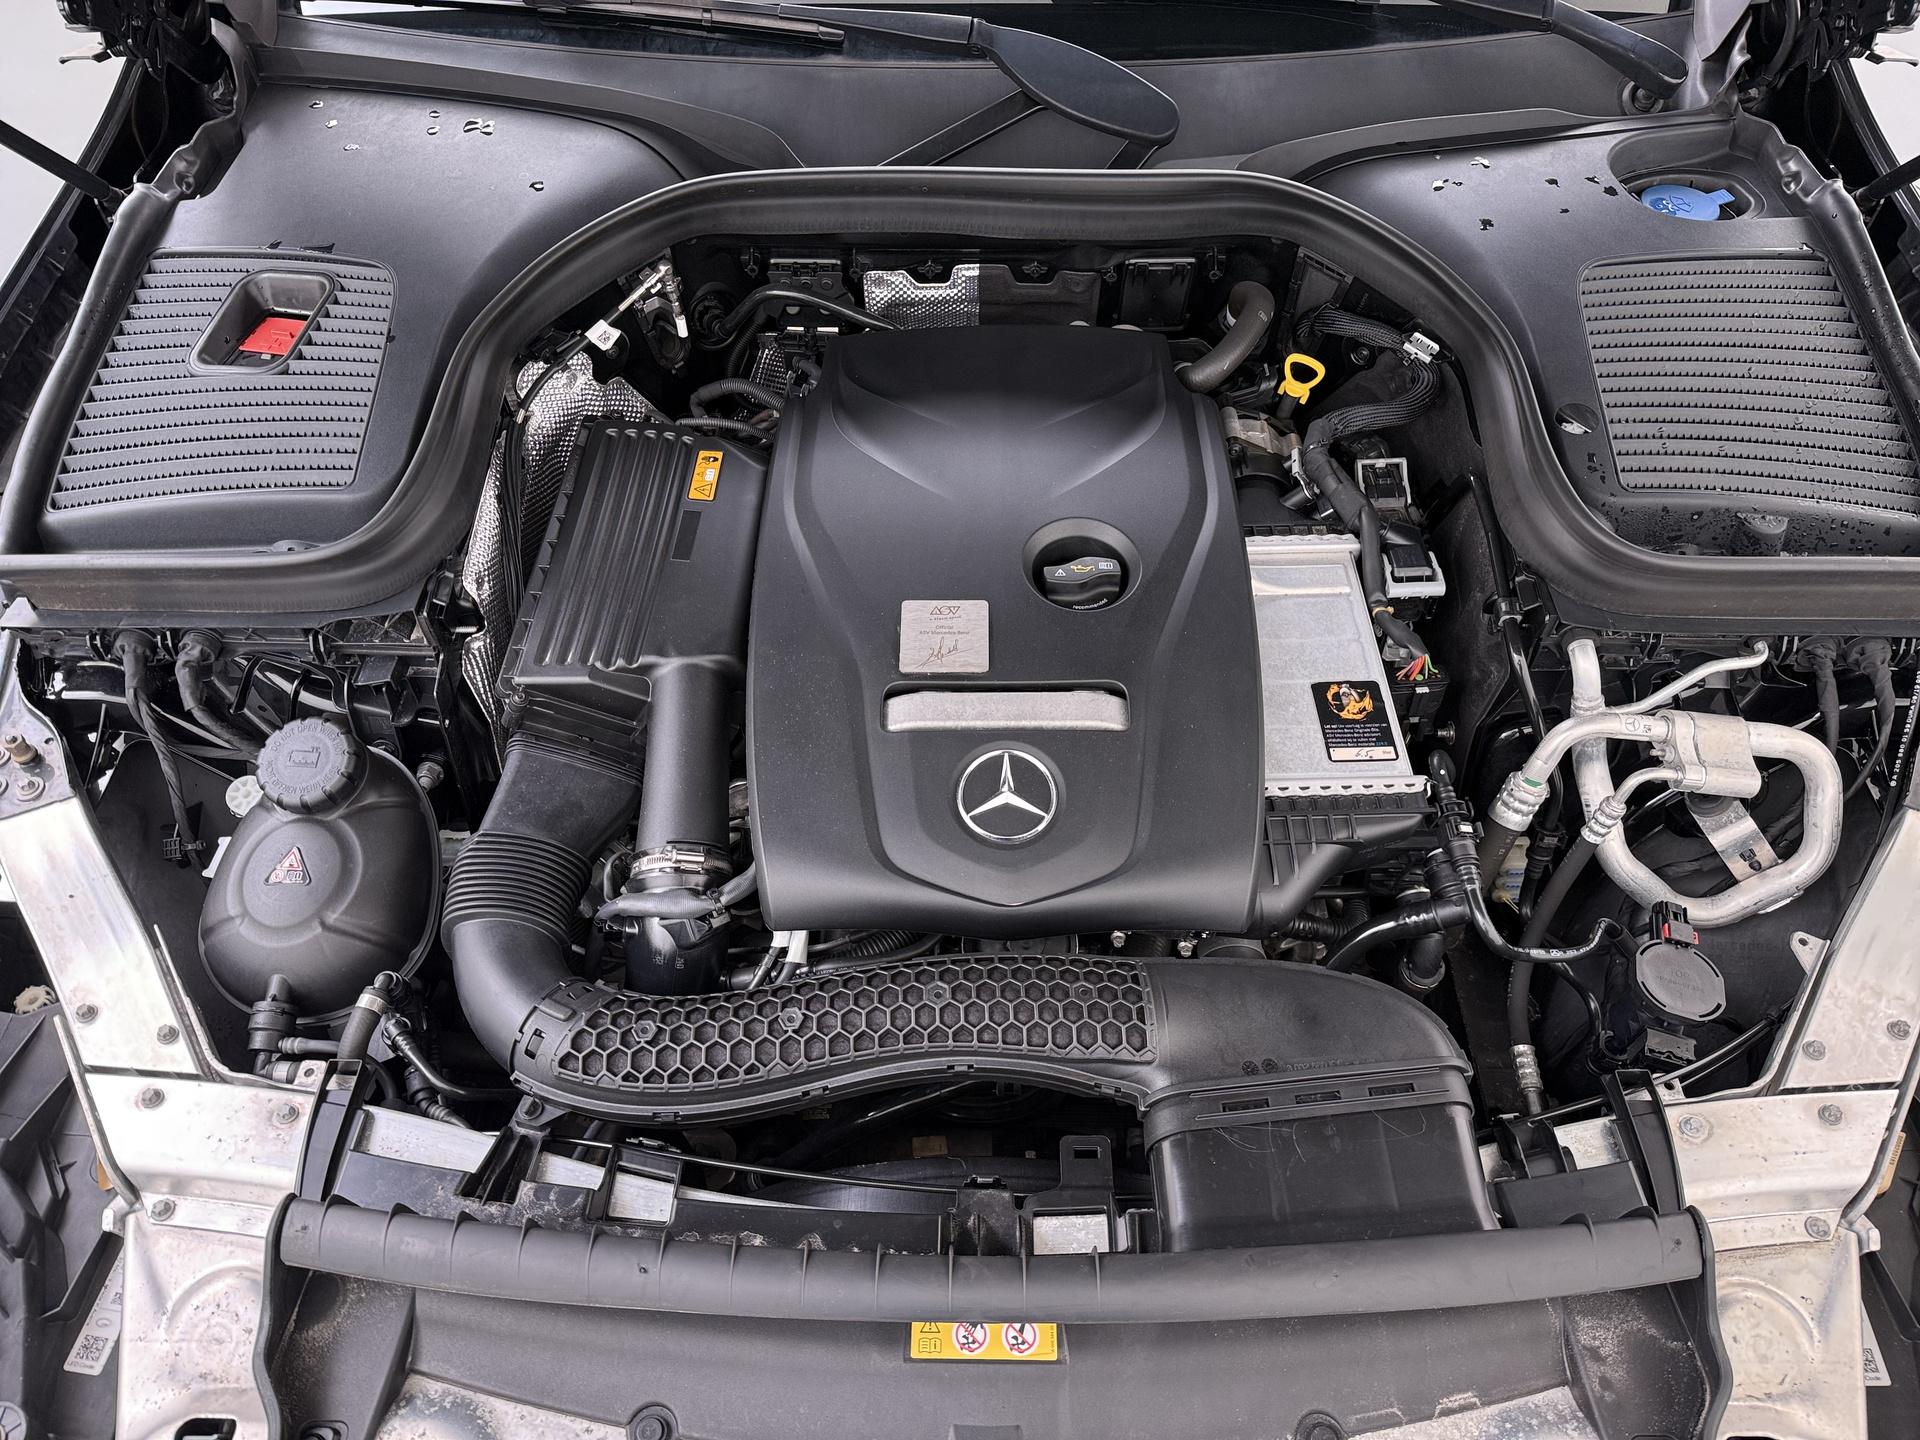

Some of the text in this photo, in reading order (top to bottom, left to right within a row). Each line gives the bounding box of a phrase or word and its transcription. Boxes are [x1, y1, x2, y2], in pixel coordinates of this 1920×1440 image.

[297, 724, 317, 734] OPEN
[1893, 759, 1902, 773] 205
[1906, 705, 1916, 723] DURA
